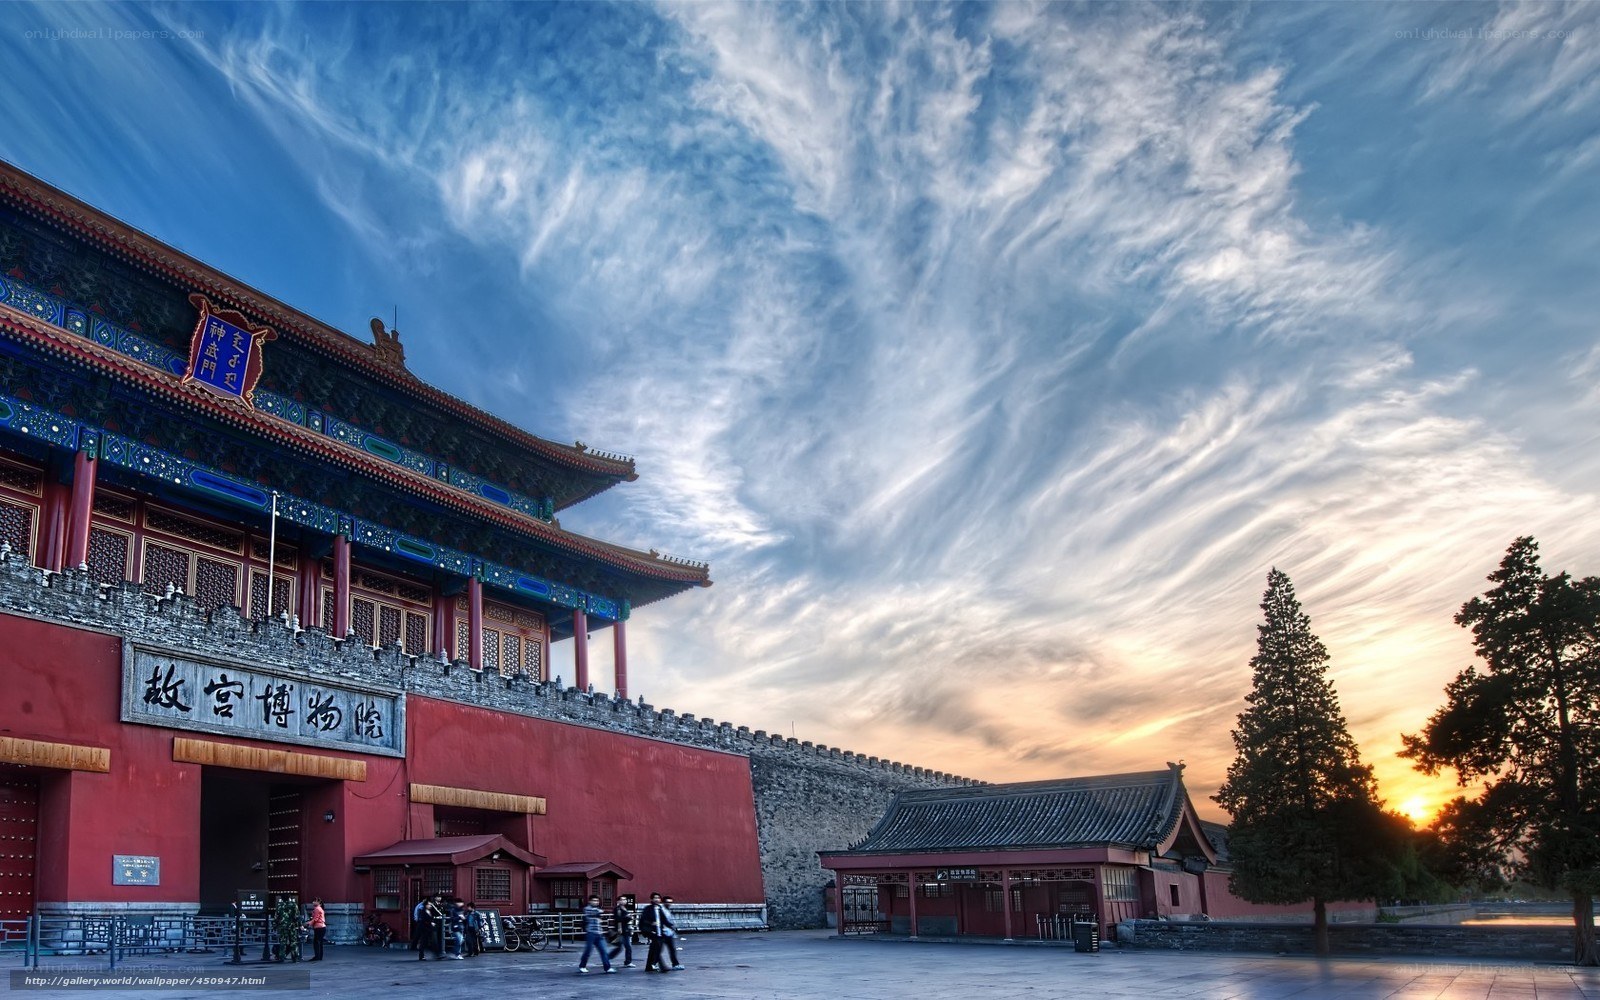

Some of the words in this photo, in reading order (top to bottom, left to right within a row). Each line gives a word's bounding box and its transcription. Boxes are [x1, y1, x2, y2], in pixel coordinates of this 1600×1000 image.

[200, 321, 227, 380] 神武門
[143, 663, 384, 739] 故宫博物院
